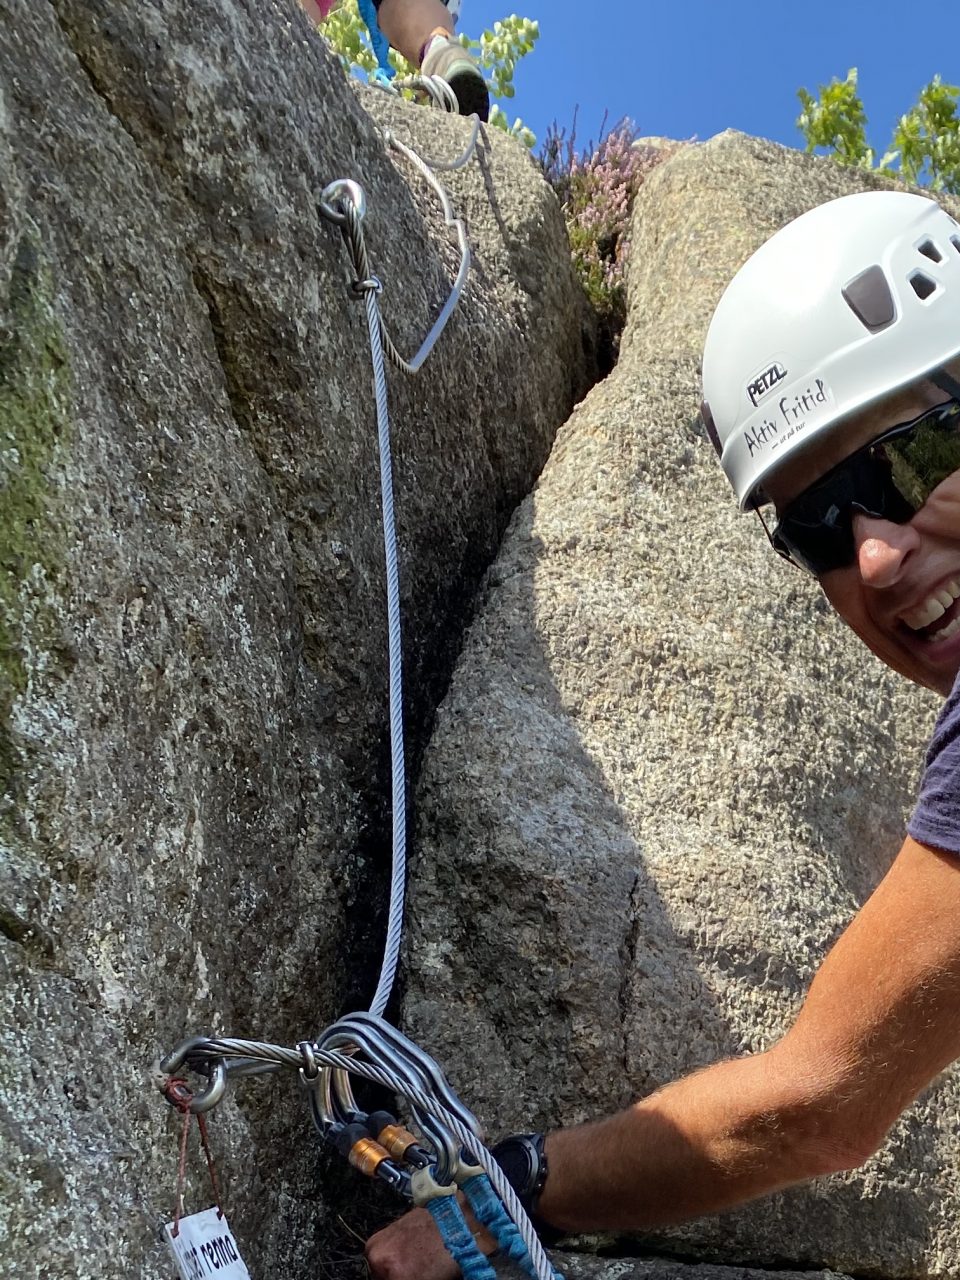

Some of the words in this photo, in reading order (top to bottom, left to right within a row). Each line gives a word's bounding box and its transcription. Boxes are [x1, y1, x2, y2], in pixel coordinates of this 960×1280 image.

[747, 365, 787, 407] PETZL
[744, 420, 778, 458] Aktiv
[779, 379, 827, 426] Fritid
[200, 1234, 239, 1273] renna
